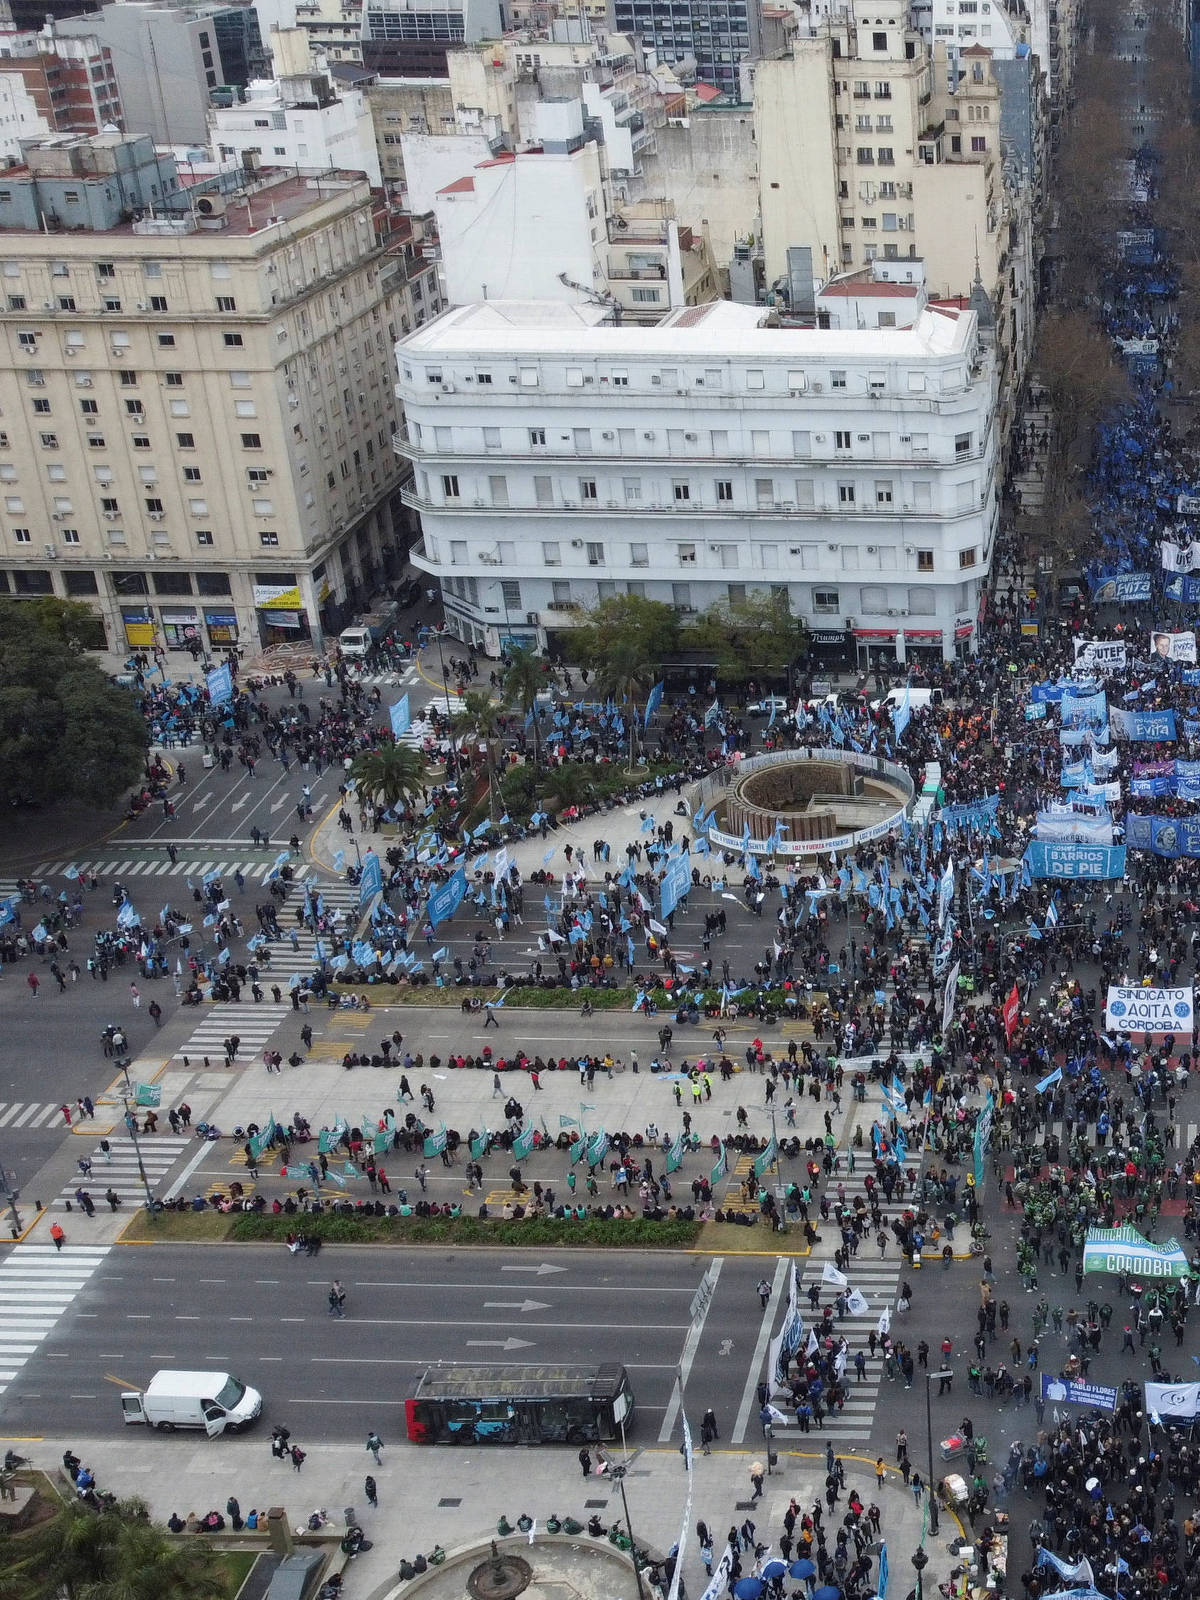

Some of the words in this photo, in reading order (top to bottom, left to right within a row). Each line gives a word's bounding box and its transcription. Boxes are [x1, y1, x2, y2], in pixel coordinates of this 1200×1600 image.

[1097, 646, 1124, 659] UTEP
[1051, 852, 1103, 861] BARRIOS
[1052, 862, 1074, 874] DE
[1079, 862, 1104, 874] PIE
[1117, 989, 1185, 1000] SINDICATO
[1127, 1003, 1172, 1018] AOITA
[1118, 1020, 1183, 1031] CORDOBA
[1088, 1224, 1131, 1241] SINDICATO
[1107, 1254, 1172, 1276] CORDOBA
[1070, 1381, 1092, 1391] PABLO
[1092, 1385, 1115, 1396] FLORES
